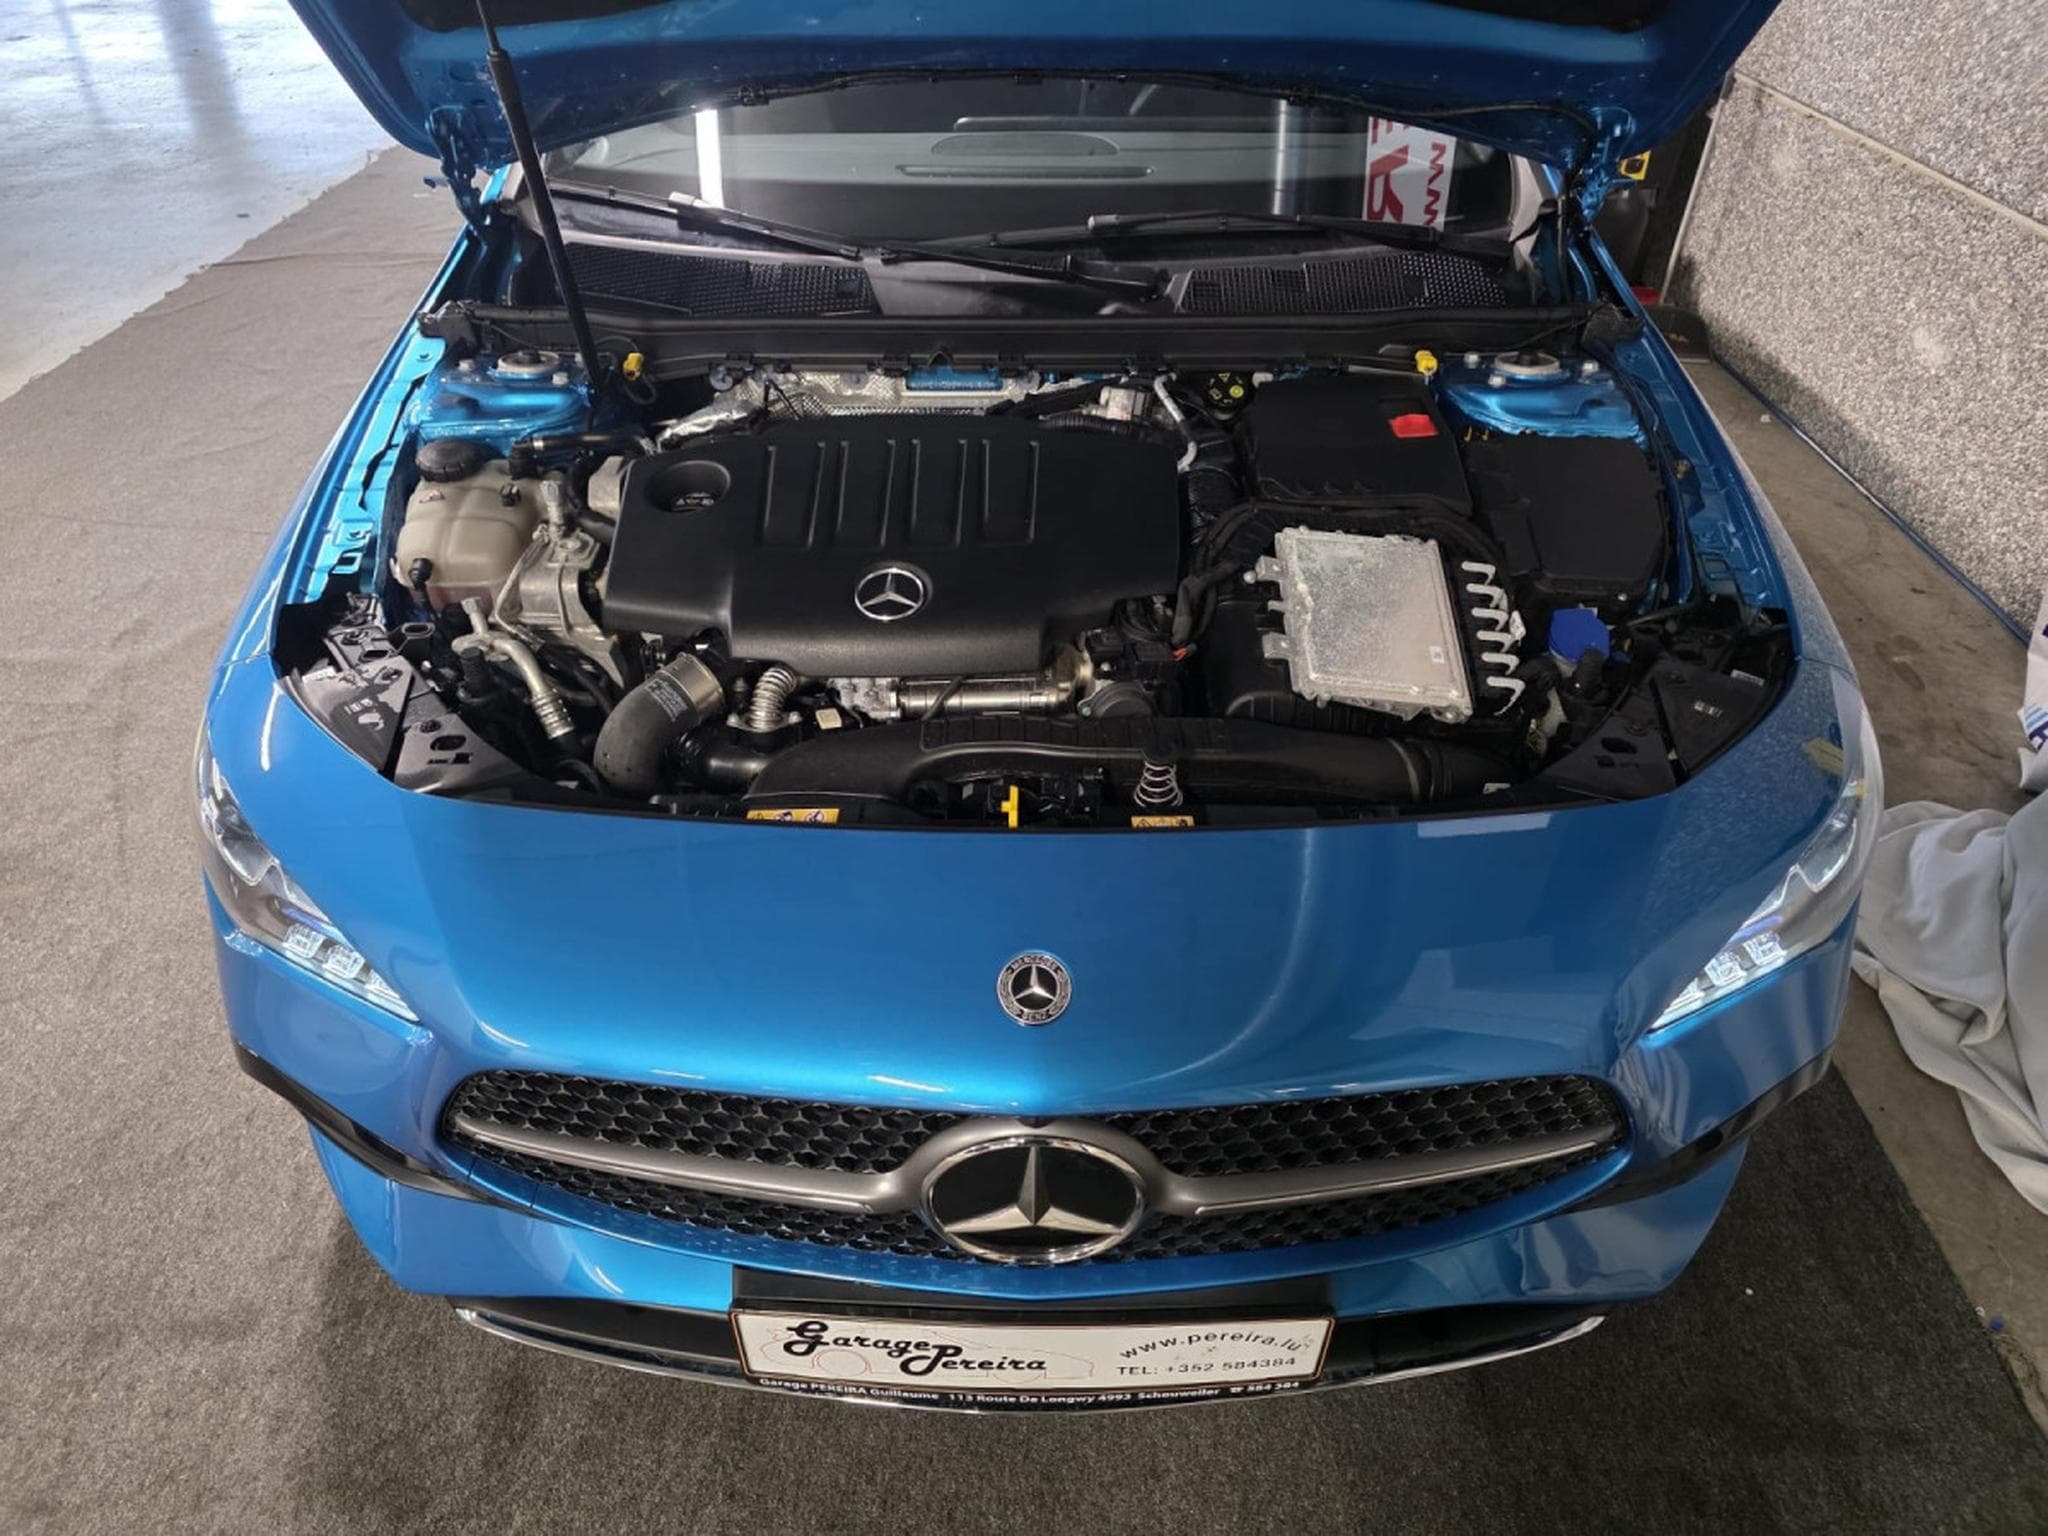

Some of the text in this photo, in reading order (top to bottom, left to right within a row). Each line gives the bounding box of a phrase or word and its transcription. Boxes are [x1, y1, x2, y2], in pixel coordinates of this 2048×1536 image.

[783, 1320, 1047, 1376] Garage Pereira
[1119, 1331, 1302, 1358] www.pereira.lu
[1116, 1357, 1296, 1375] TEL: +352 584384
[759, 1378, 808, 1391] Garage
[810, 1382, 868, 1395] PEREIRA
[869, 1387, 939, 1400] Guillaume
[977, 1394, 1017, 1403] Route
[1019, 1395, 1039, 1403] De
[1041, 1395, 1096, 1405] Longwy
[1098, 1393, 1132, 1402] 4993
